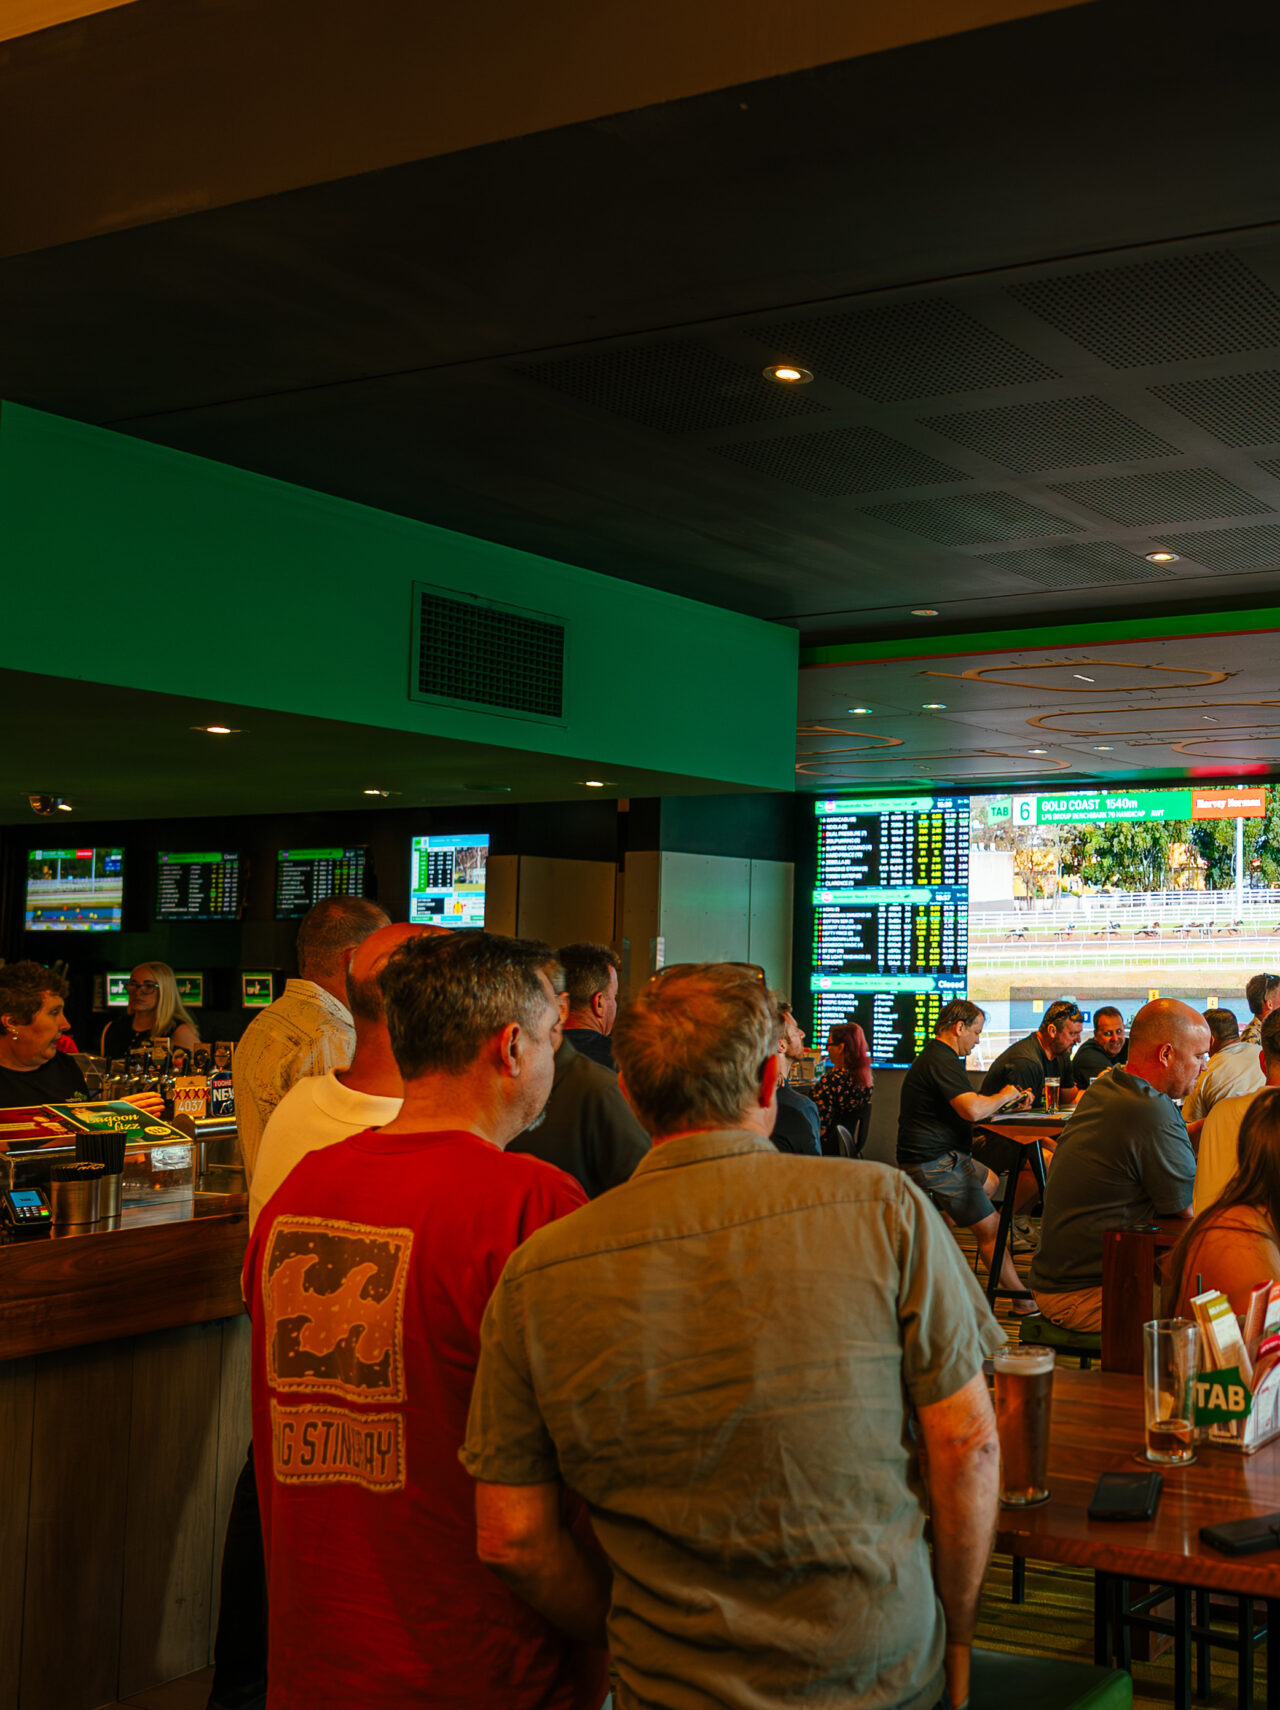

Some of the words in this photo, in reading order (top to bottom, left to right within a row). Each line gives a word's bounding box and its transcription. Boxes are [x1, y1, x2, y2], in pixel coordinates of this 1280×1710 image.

[1019, 801, 1030, 820] 6
[1042, 800, 1067, 811] GOLD
[1068, 799, 1100, 810] COAST
[1105, 798, 1138, 809] 1540m
[990, 806, 1009, 816] TAB
[938, 980, 965, 989] Closed
[174, 1088, 210, 1100] XXXX
[178, 1100, 204, 1112] 4037
[86, 1114, 139, 1127] Lagoon
[1195, 1382, 1246, 1412] TAB
